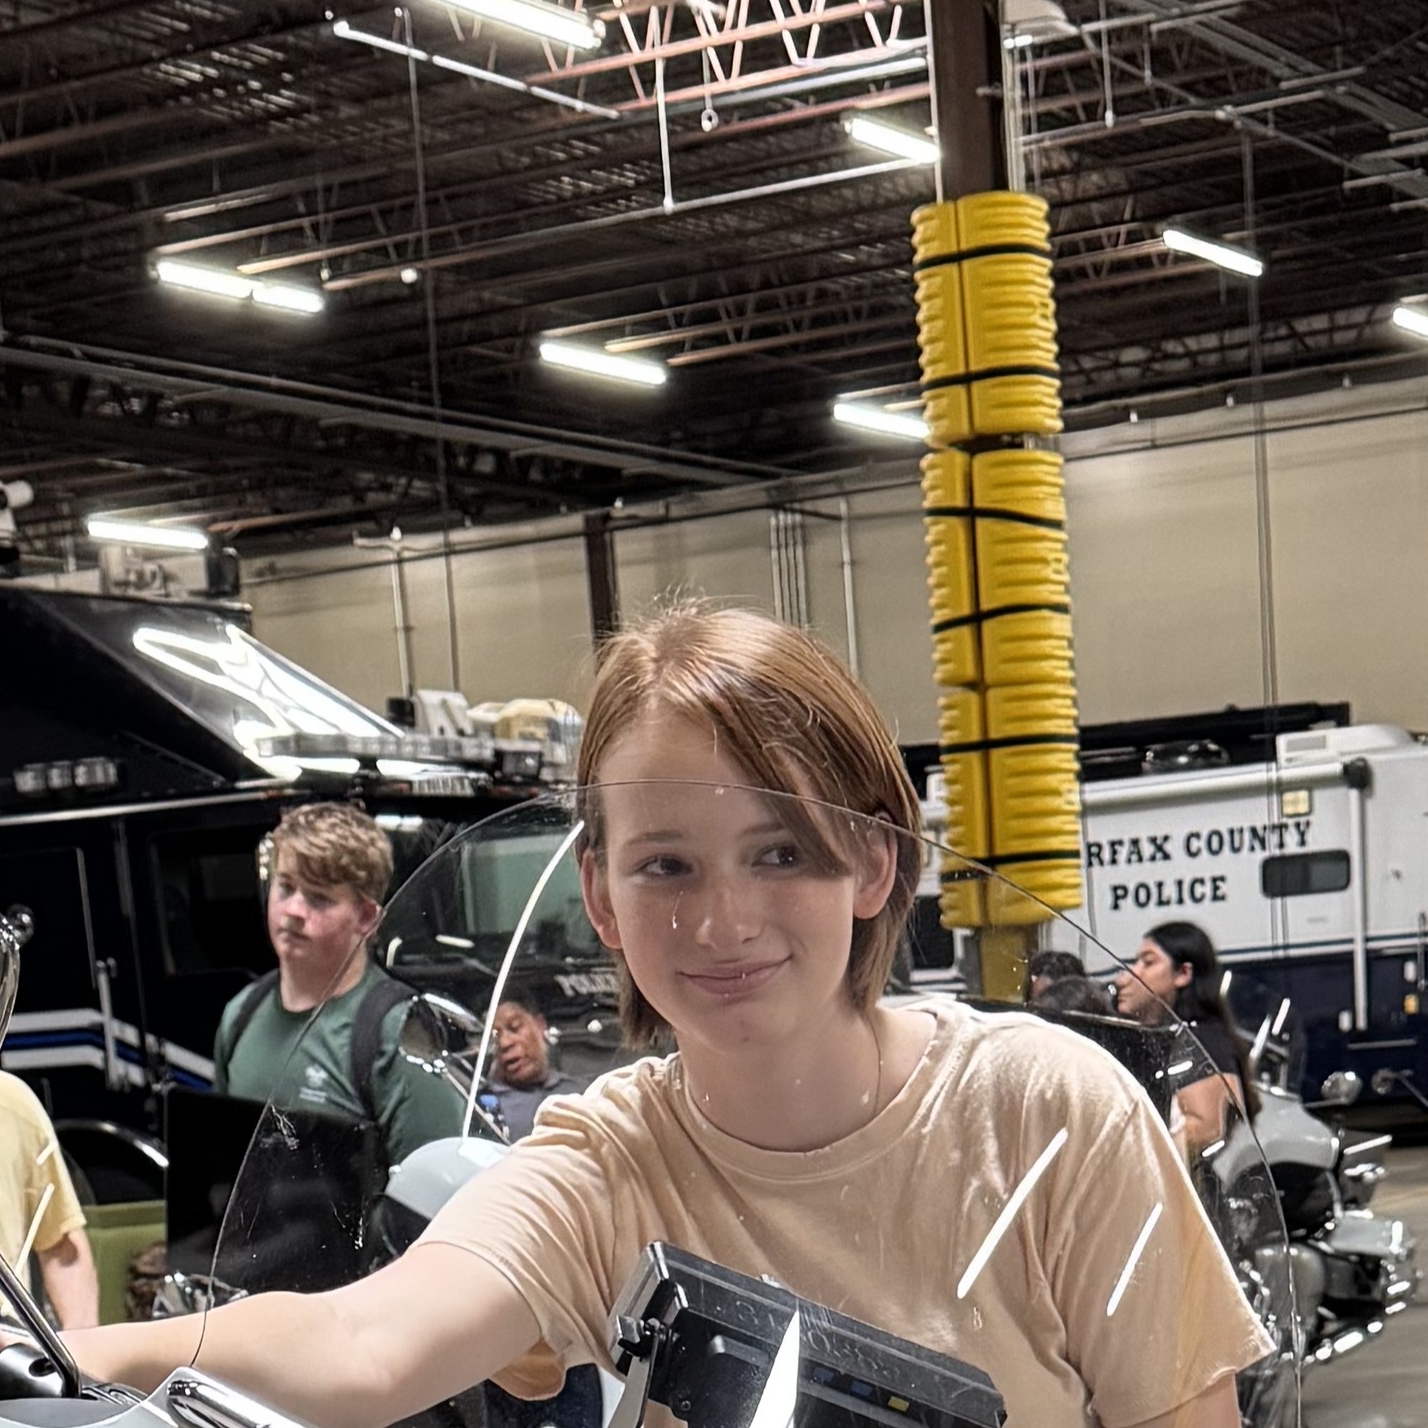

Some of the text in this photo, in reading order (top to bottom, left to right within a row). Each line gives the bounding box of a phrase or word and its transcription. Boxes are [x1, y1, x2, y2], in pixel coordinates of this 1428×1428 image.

[1085, 820, 1311, 868] RFAX COUNTY
[1109, 875, 1227, 911] POLICE
